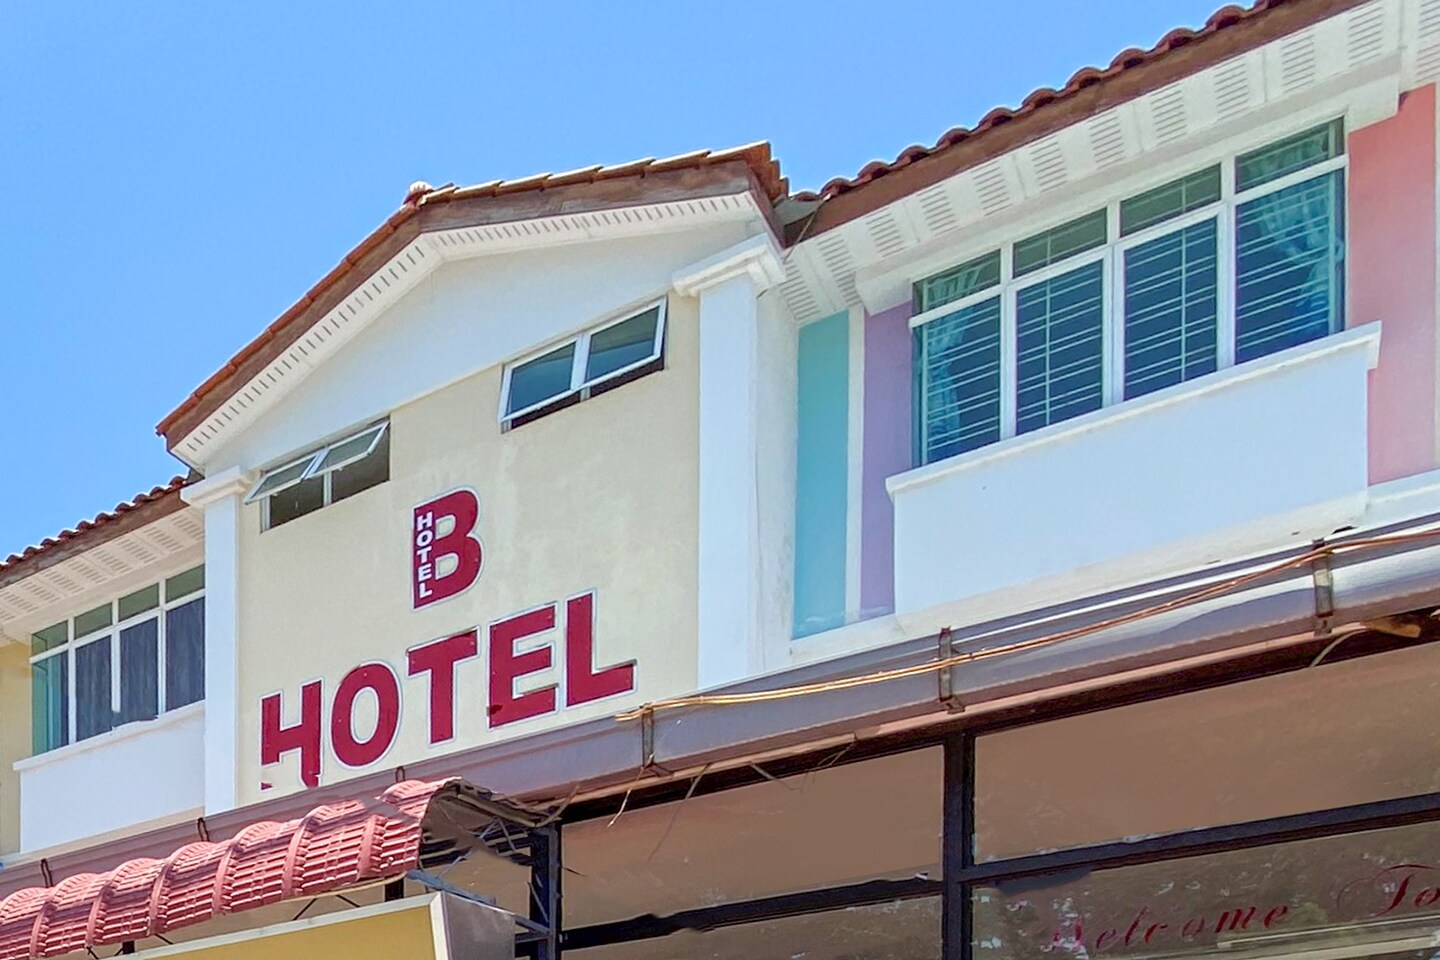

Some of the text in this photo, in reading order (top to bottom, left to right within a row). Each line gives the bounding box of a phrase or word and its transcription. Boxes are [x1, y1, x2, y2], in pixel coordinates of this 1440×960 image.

[412, 488, 484, 611] B
[416, 511, 433, 599] HOTEL
[260, 588, 637, 790] HOTEL
